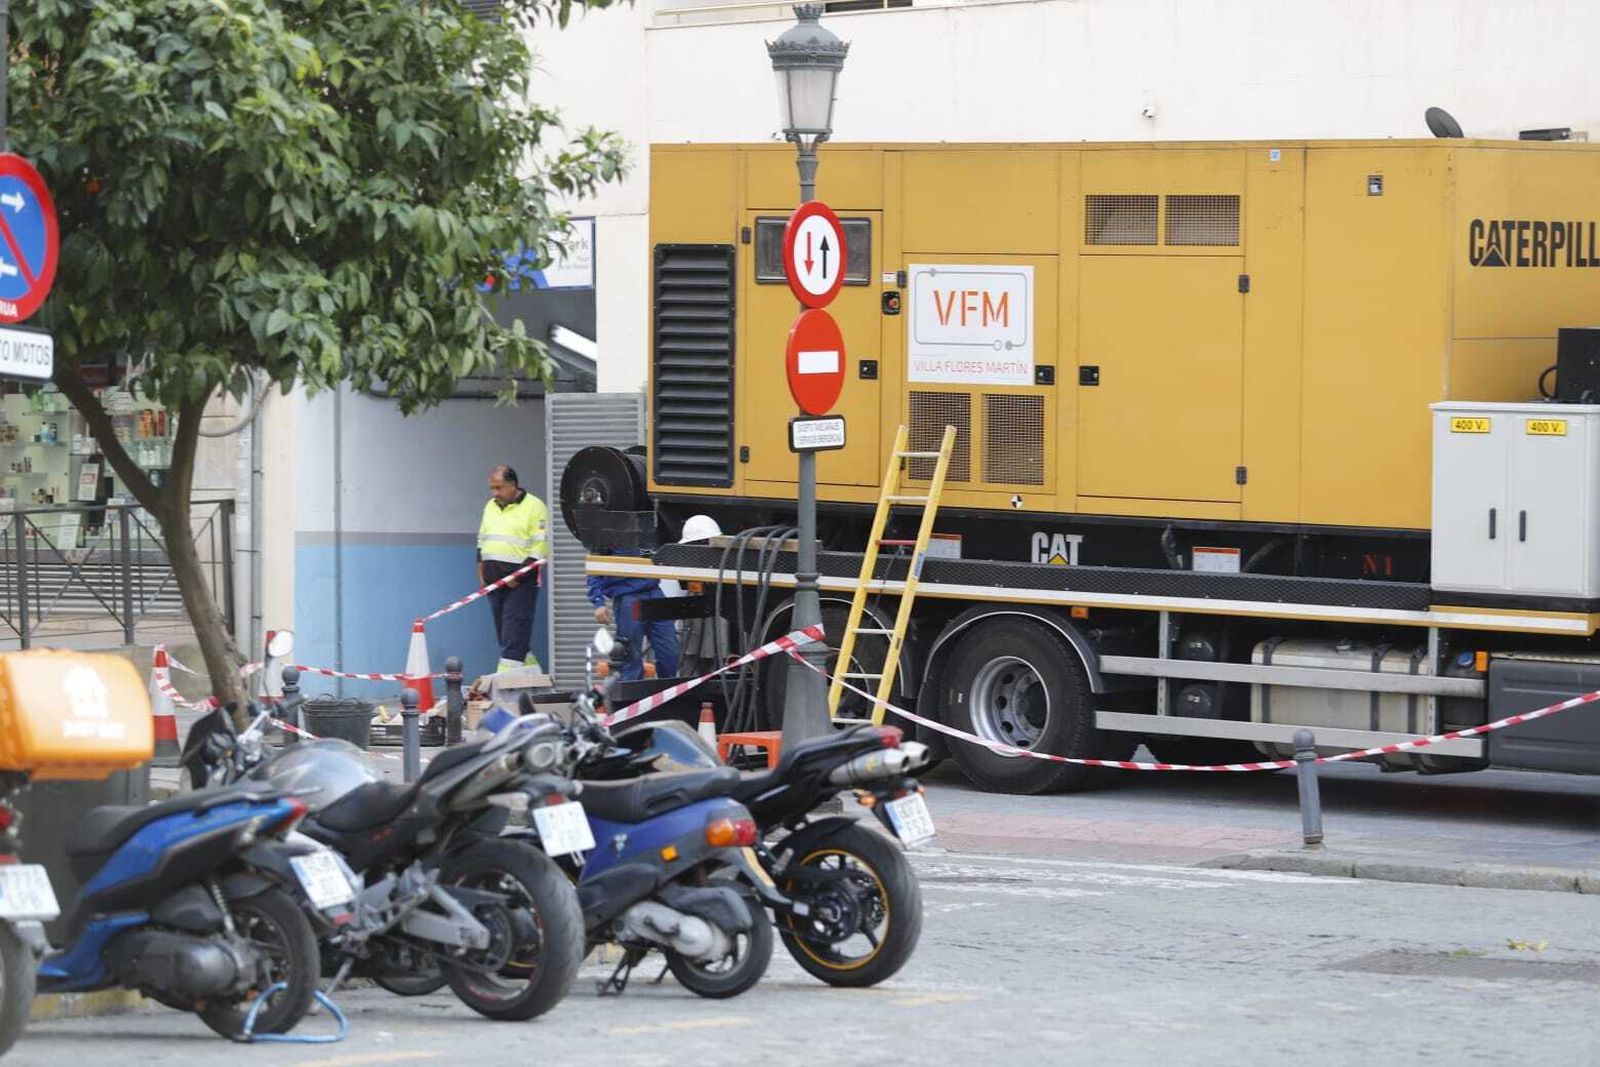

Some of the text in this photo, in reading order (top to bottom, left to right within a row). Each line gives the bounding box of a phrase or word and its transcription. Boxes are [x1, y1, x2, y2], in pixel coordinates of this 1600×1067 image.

[1469, 218, 1600, 267] CATERPILL
[932, 289, 1009, 328] VFM
[13, 341, 50, 366] MOTOS
[913, 360, 943, 372] VILLA
[945, 361, 984, 374] FLORES
[1455, 419, 1473, 430] 400
[1530, 422, 1549, 432] 400
[1031, 531, 1084, 566] CAT
